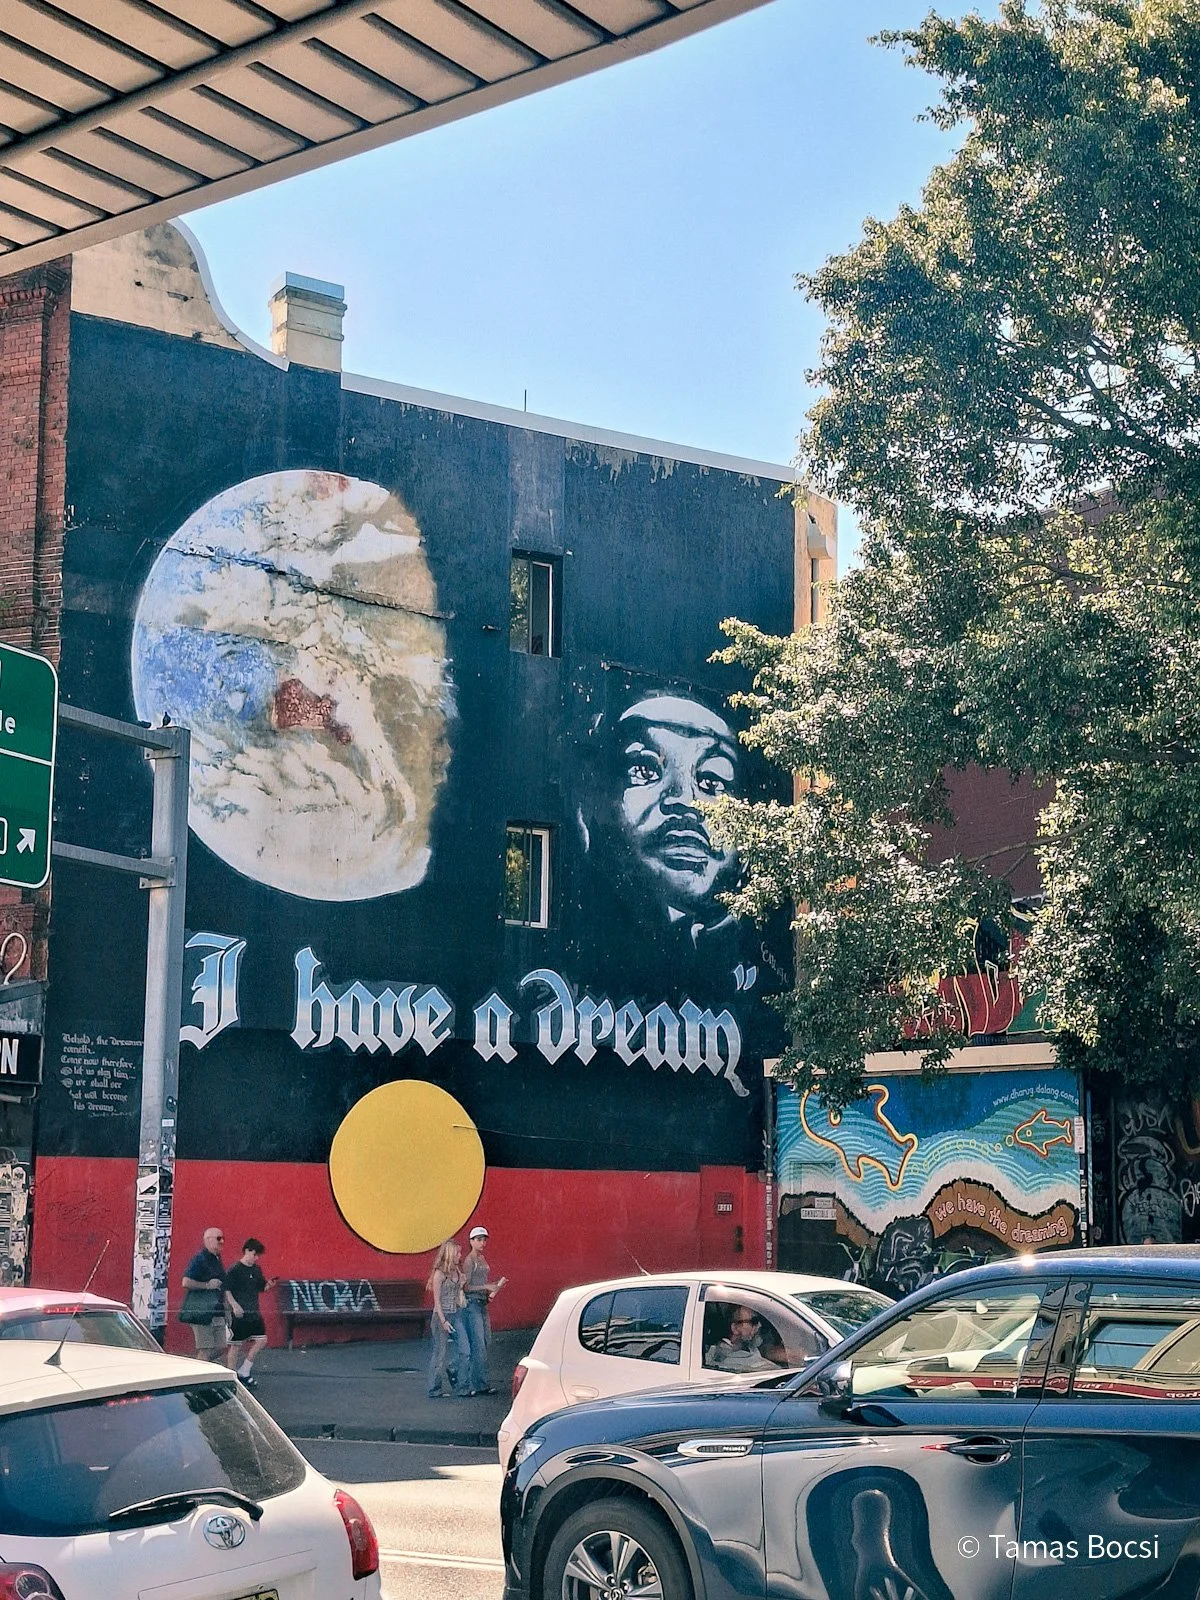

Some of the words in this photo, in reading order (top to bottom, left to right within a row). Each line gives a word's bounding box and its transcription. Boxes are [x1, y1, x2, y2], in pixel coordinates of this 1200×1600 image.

[290, 947, 452, 1056] have
[473, 993, 518, 1064] a
[0, 1038, 19, 1075] N
[957, 1192, 986, 1217] have
[988, 1207, 1008, 1234] the
[1011, 1216, 1069, 1243] dreaming
